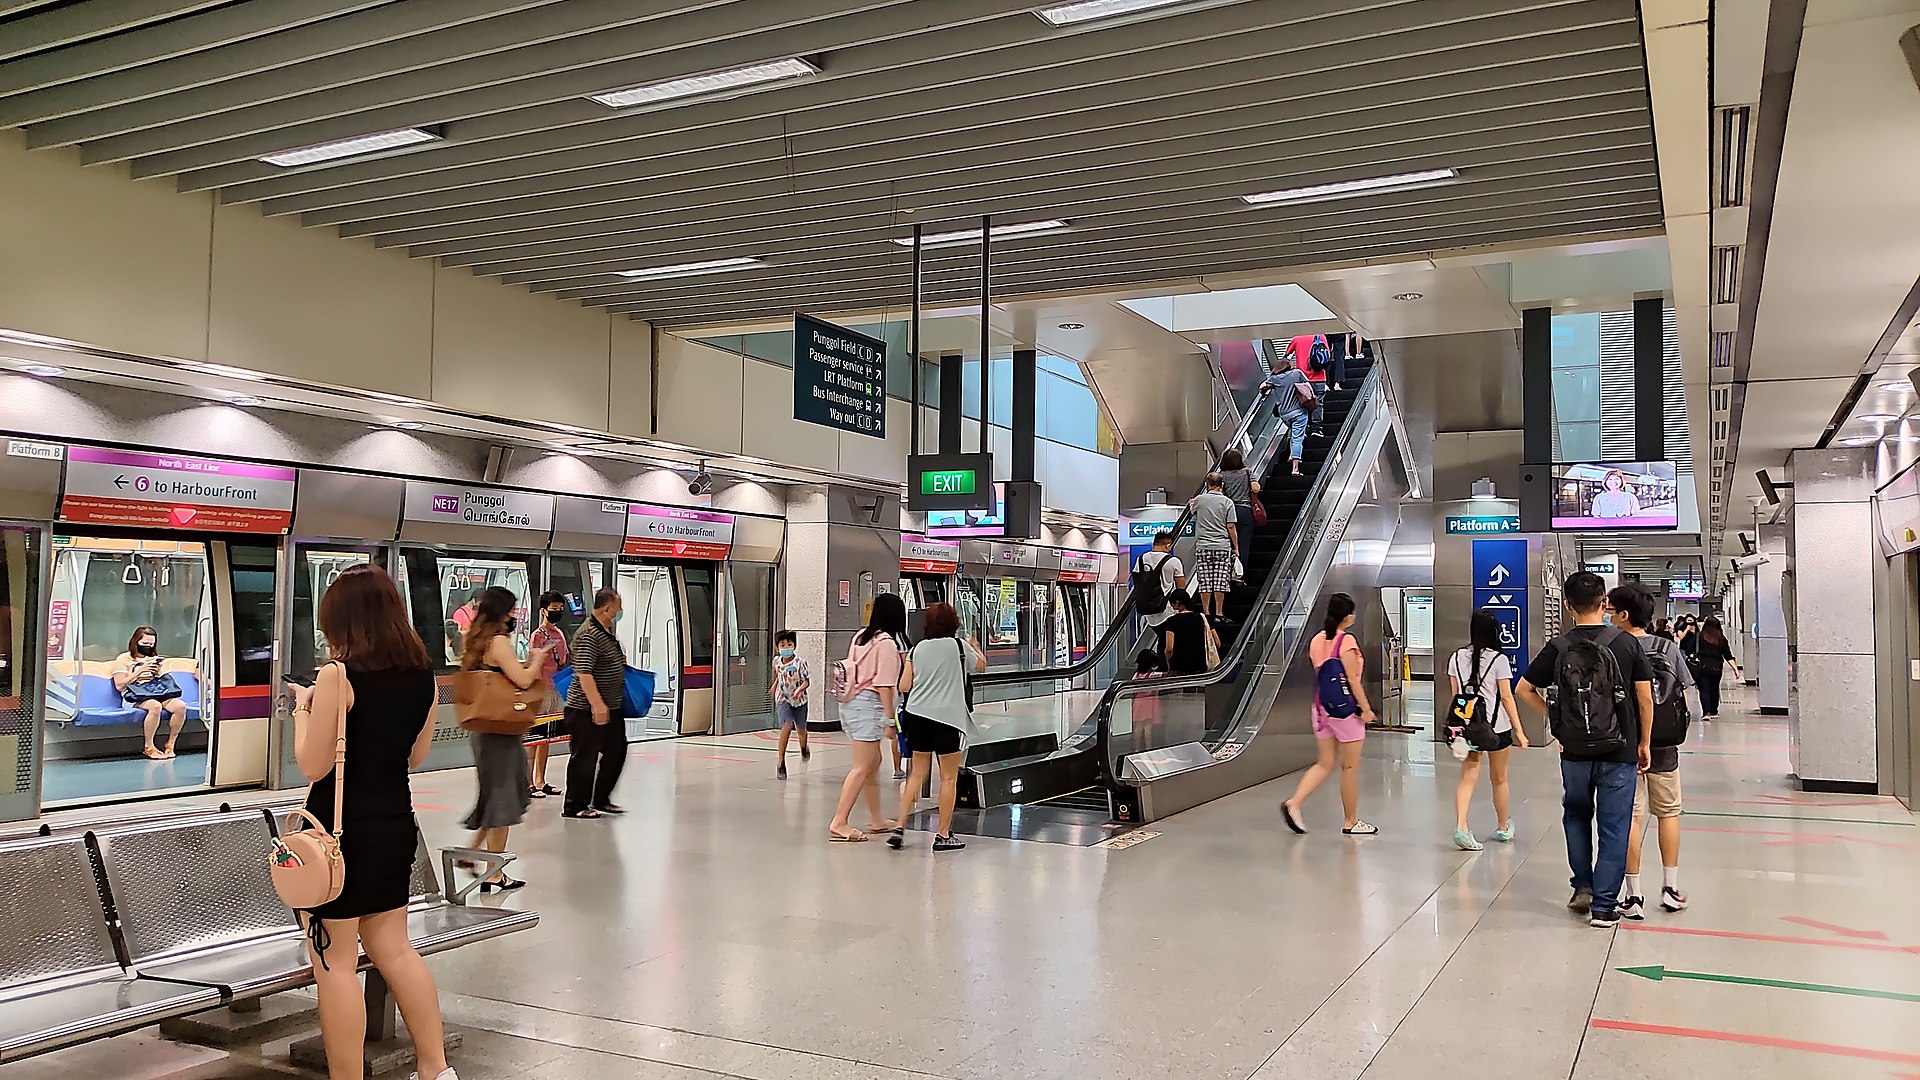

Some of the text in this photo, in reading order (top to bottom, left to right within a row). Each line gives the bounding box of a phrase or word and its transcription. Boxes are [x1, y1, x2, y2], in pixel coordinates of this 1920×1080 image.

[813, 330, 839, 350] Punggol
[841, 340, 856, 355] Field
[809, 347, 864, 375] Passenger service
[824, 370, 864, 392] LRT Platform
[813, 385, 864, 410] Bus Interchange
[829, 407, 843, 424] Way
[844, 413, 855, 425] out
[11, 442, 50, 456] Platform
[158, 458, 221, 472] North East Line
[137, 478, 257, 500] 6 to HarbourFront
[933, 474, 963, 492] EXIT
[433, 491, 505, 510] NE17 Punggol
[666, 526, 673, 534] to
[674, 526, 715, 537] HarbourFront
[1186, 525, 1193, 534] B
[1449, 519, 1510, 530] Platform A
